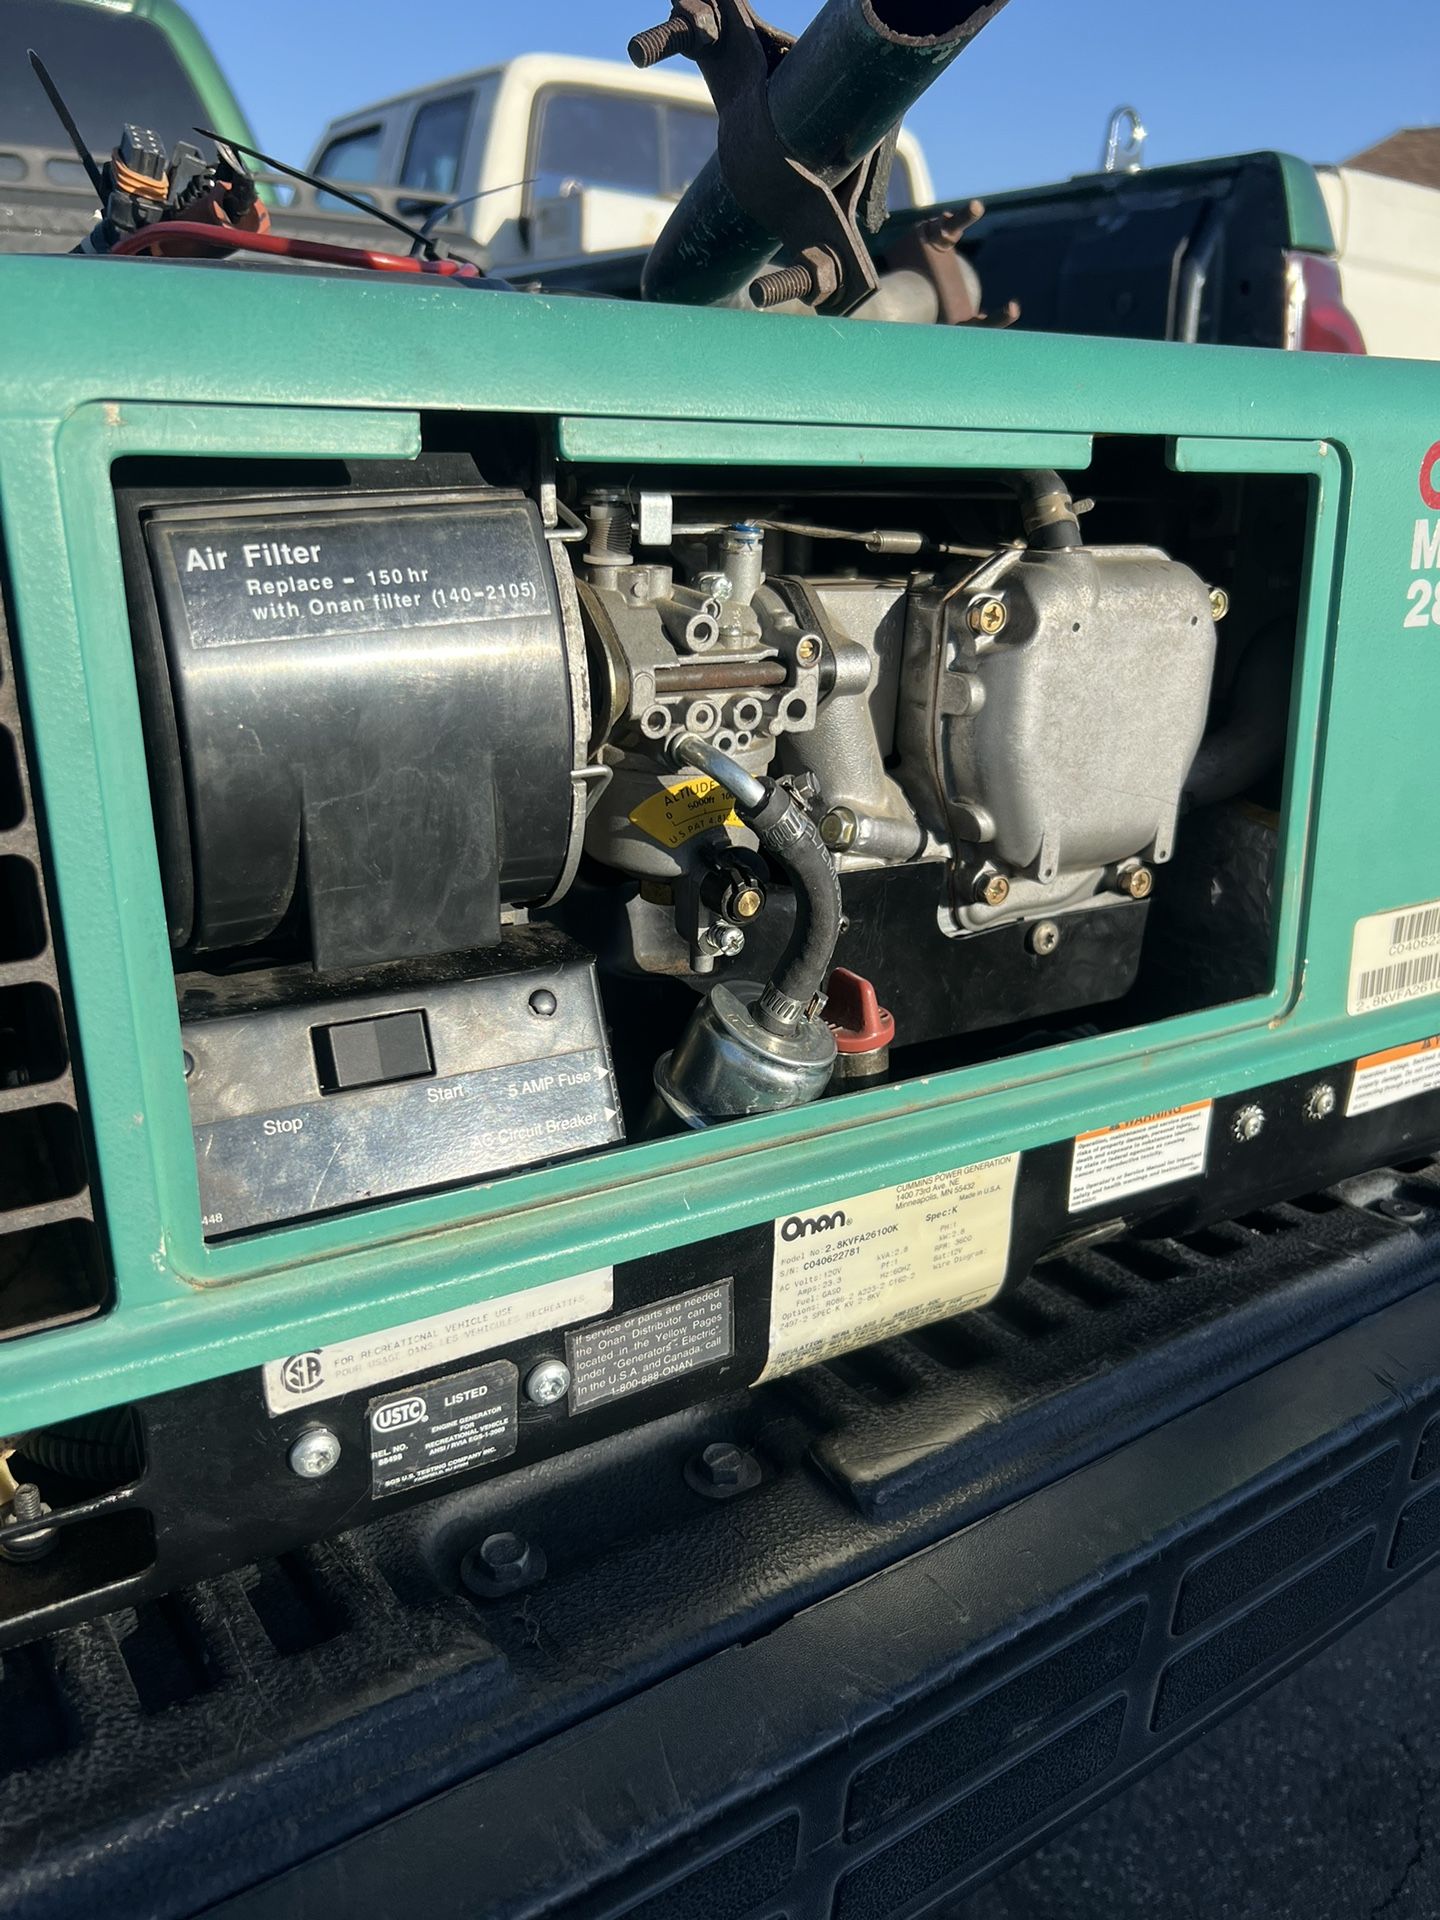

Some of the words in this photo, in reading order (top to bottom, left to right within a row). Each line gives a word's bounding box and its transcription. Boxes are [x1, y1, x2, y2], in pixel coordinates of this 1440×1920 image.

[186, 548, 228, 572] Air
[243, 542, 322, 568] Filter
[246, 575, 334, 599] Replace
[367, 569, 403, 586] 150
[408, 568, 429, 584] hr
[252, 602, 300, 622] with
[311, 597, 365, 617] Onan
[374, 593, 421, 611] filter
[432, 581, 538, 610] (140-2105)
[427, 1083, 465, 1103] Start
[508, 1082, 518, 1098] 5
[520, 1077, 555, 1096] AMP
[558, 1069, 592, 1088] Fuse
[263, 1115, 304, 1137] Stop
[499, 1121, 543, 1144] Circuit
[545, 1110, 598, 1133] Breaker
[896, 1176, 933, 1194] CUMMINS
[934, 1168, 963, 1182] POWER
[964, 1156, 1012, 1174] GENERATION
[896, 1191, 914, 1202] 1400
[915, 1186, 931, 1197] 73rd
[949, 1178, 960, 1187] NE
[940, 1188, 953, 1197] MN
[954, 1182, 975, 1194] 55432
[959, 1192, 975, 1201] Made
[781, 1210, 846, 1242] Onan
[925, 1205, 958, 1222] Spec:K
[781, 1252, 805, 1265] Model
[334, 1355, 355, 1367] FOR
[361, 1330, 438, 1358] RECREATIONAL
[446, 1313, 488, 1332] VEHICLE
[495, 1305, 513, 1317] USE
[576, 1346, 592, 1358] the
[598, 1335, 625, 1350] Onan
[632, 1316, 682, 1338] Distributor
[687, 1308, 705, 1319] can
[710, 1301, 722, 1311] be
[585, 1323, 622, 1342] service
[624, 1320, 635, 1330] or
[638, 1310, 663, 1327] parts
[666, 1303, 681, 1315] are
[577, 1352, 614, 1371] located
[619, 1346, 628, 1356] in
[634, 1339, 649, 1350] the
[655, 1326, 687, 1342] Yellow
[693, 1314, 722, 1330] Pages
[577, 1385, 587, 1396] In
[590, 1379, 605, 1390] the
[642, 1358, 661, 1372] and
[705, 1336, 721, 1349] call
[577, 1366, 606, 1383] under
[444, 1385, 488, 1407] LISTED
[379, 1400, 420, 1428] USTC
[431, 1419, 458, 1433] ENGINE
[459, 1405, 502, 1424] GENERATOR
[459, 1421, 475, 1431] FOR
[425, 1428, 479, 1449] RECREATIONAL
[480, 1417, 509, 1432] VEHICLE
[393, 1443, 409, 1454] NO.
[448, 1451, 482, 1466] COMPANY
